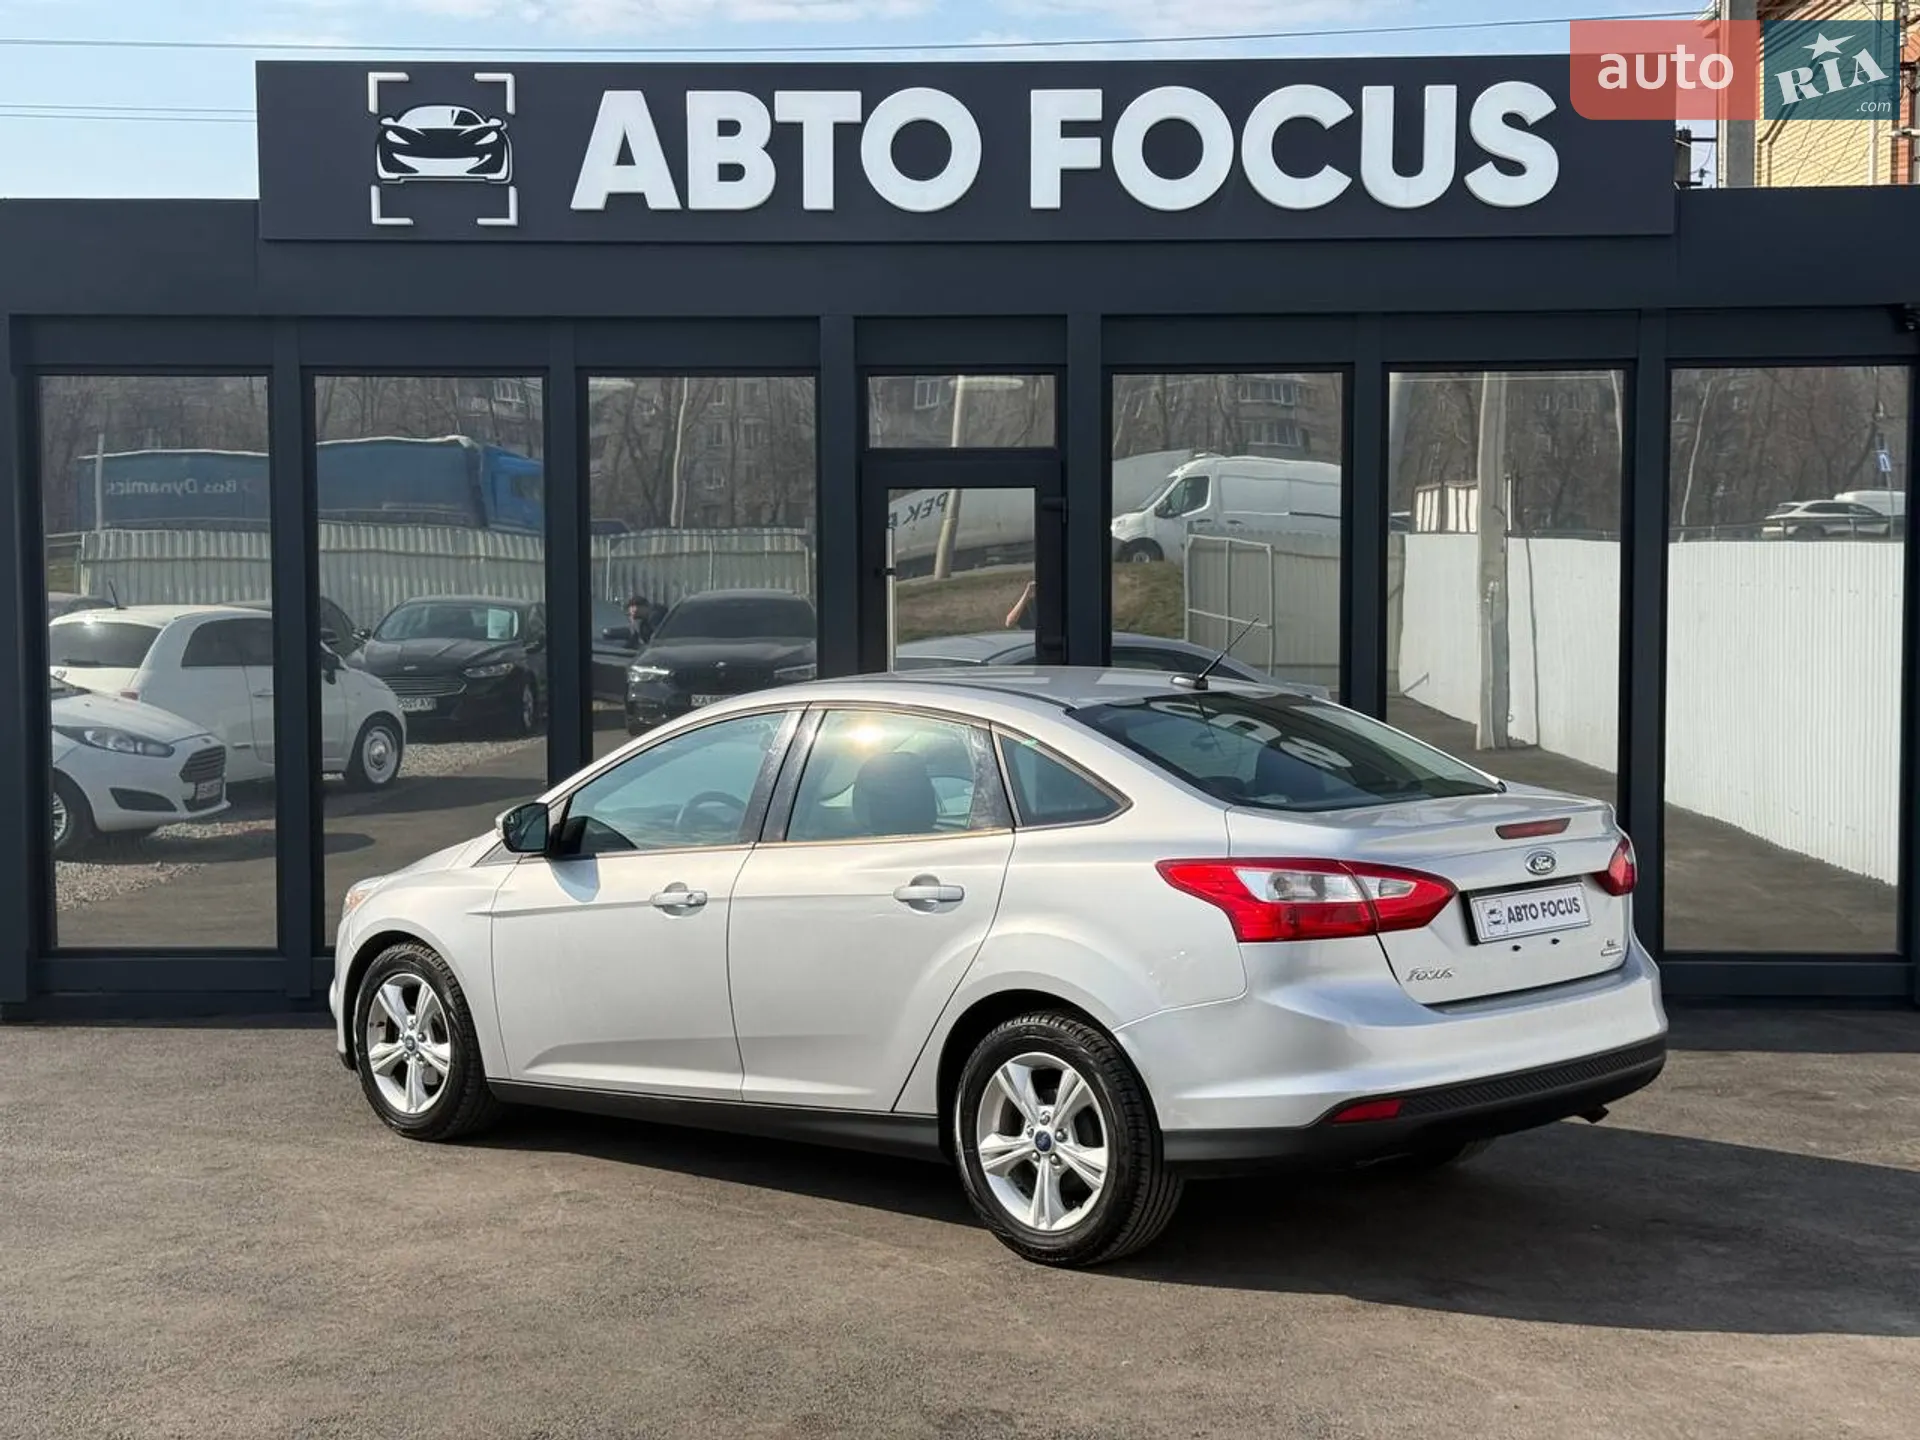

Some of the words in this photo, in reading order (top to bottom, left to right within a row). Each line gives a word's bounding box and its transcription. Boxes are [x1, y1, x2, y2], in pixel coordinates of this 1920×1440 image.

[570, 86, 983, 213] АВТО
[1029, 80, 1560, 212] FOCUS
[1507, 903, 1540, 924] АВТО
[1540, 896, 1581, 918] FOCUS
